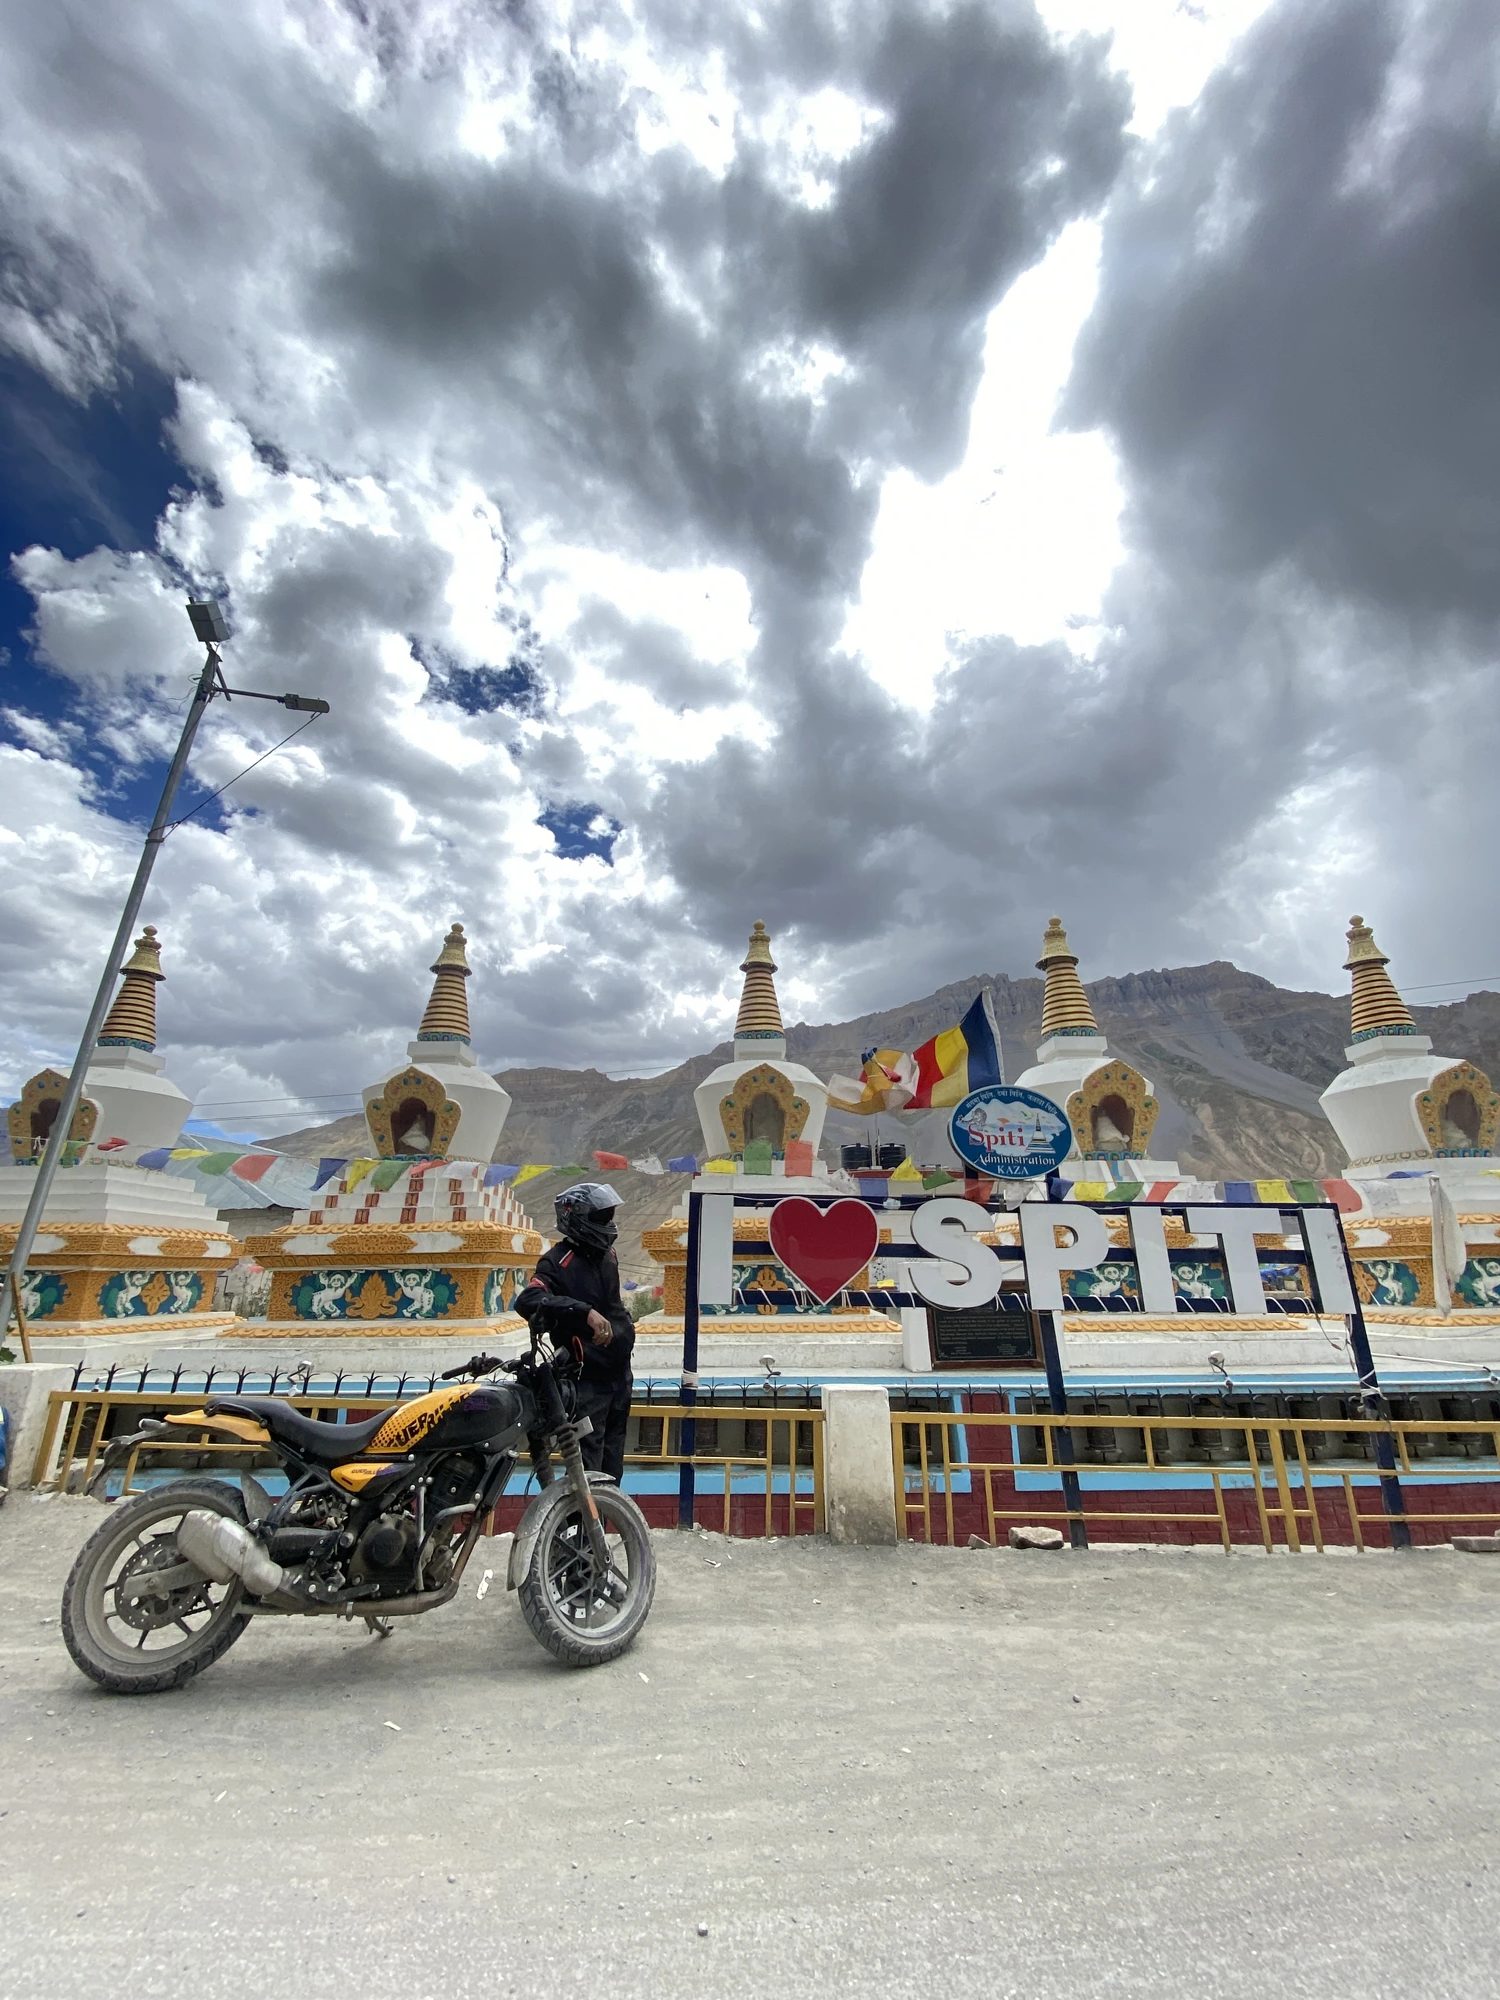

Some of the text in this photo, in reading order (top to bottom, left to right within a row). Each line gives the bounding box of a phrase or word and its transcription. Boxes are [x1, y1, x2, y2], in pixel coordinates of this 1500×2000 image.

[967, 1122, 1026, 1153] Spiti
[974, 1153, 1056, 1166] Administration
[997, 1165, 1029, 1176] KAZA
[699, 1194, 1357, 1315] I SPITI
